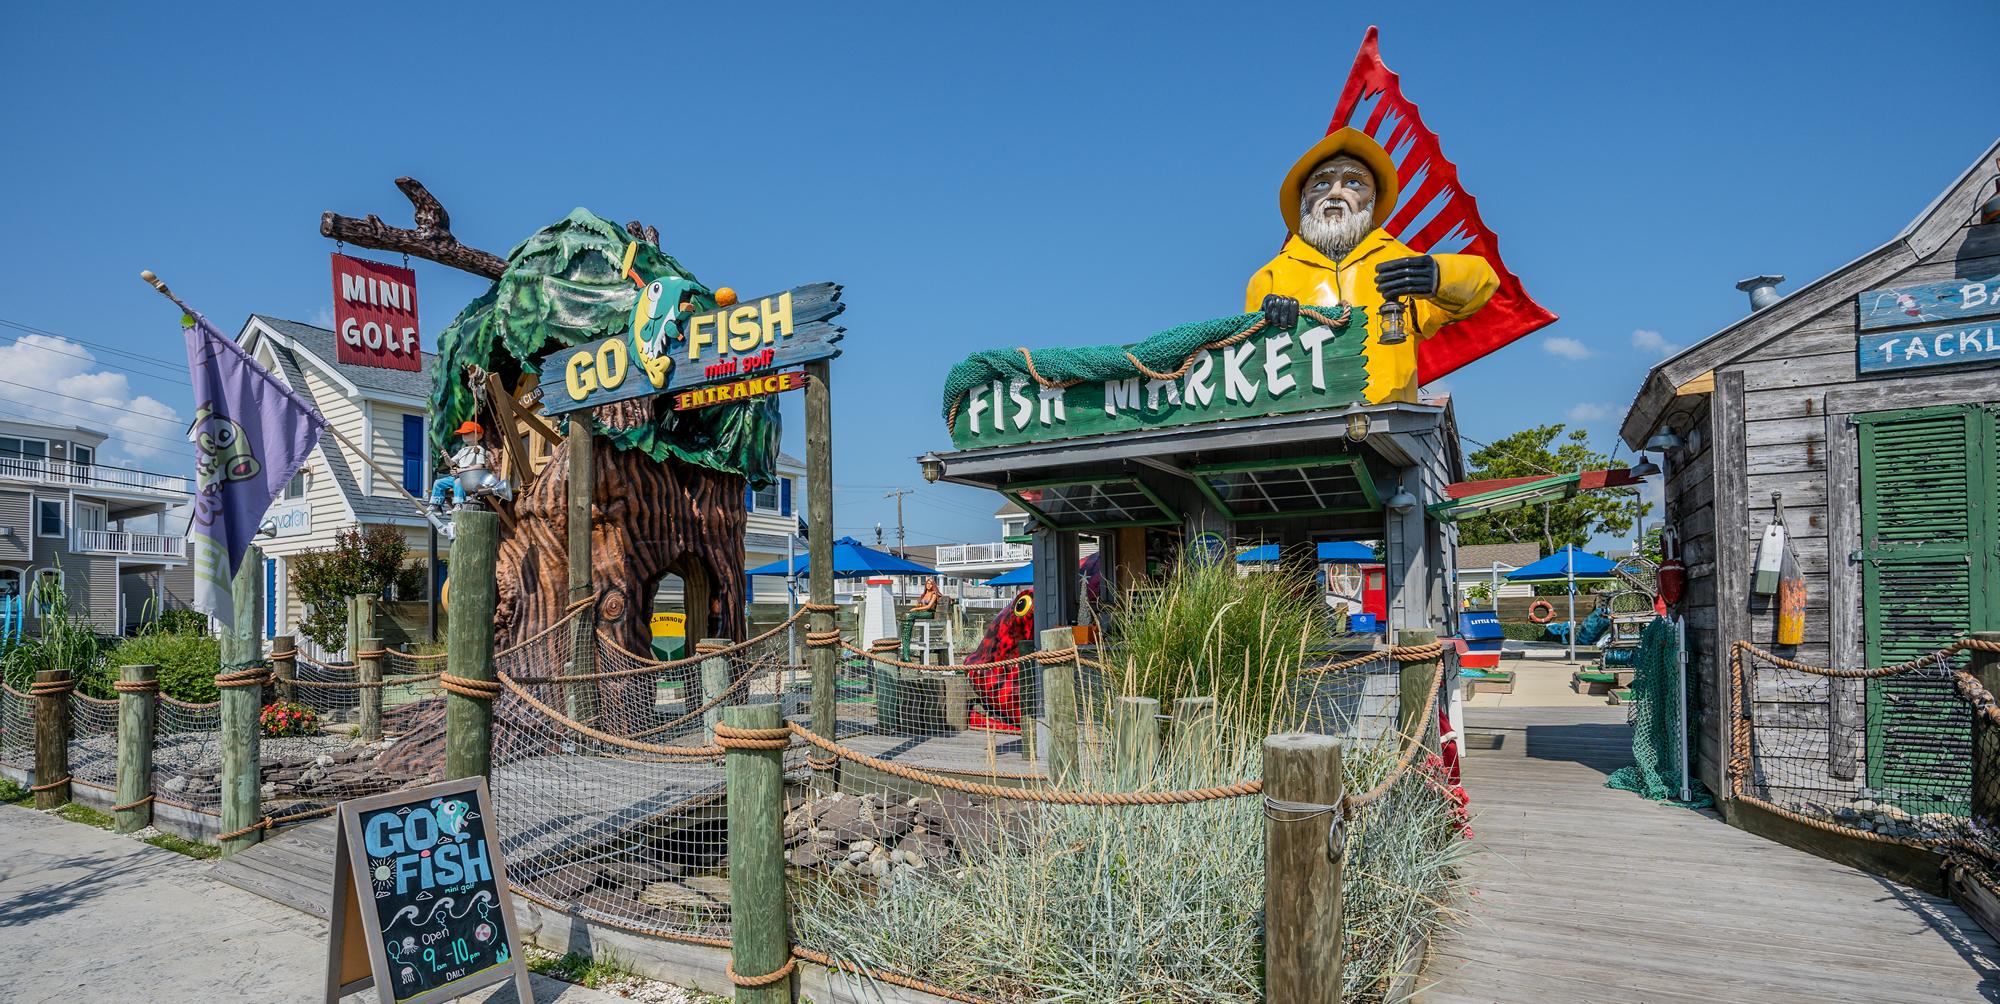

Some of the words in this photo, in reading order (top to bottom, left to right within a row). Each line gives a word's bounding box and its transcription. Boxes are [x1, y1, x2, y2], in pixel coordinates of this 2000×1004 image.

[341, 272, 412, 312] MINI
[341, 317, 416, 355] GOLF
[565, 337, 629, 401] GO
[687, 290, 794, 361] FISH
[704, 356, 738, 378] mini
[742, 348, 776, 374] golf
[967, 376, 1067, 435] FISH
[1104, 324, 1335, 419] MARKET
[523, 387, 542, 404] CLUB
[681, 374, 792, 409] ENTRANCE
[365, 807, 439, 859] GO
[444, 884, 459, 894] mini
[460, 881, 475, 894] golf
[421, 928, 450, 945] Open
[445, 967, 466, 981] DAILY
